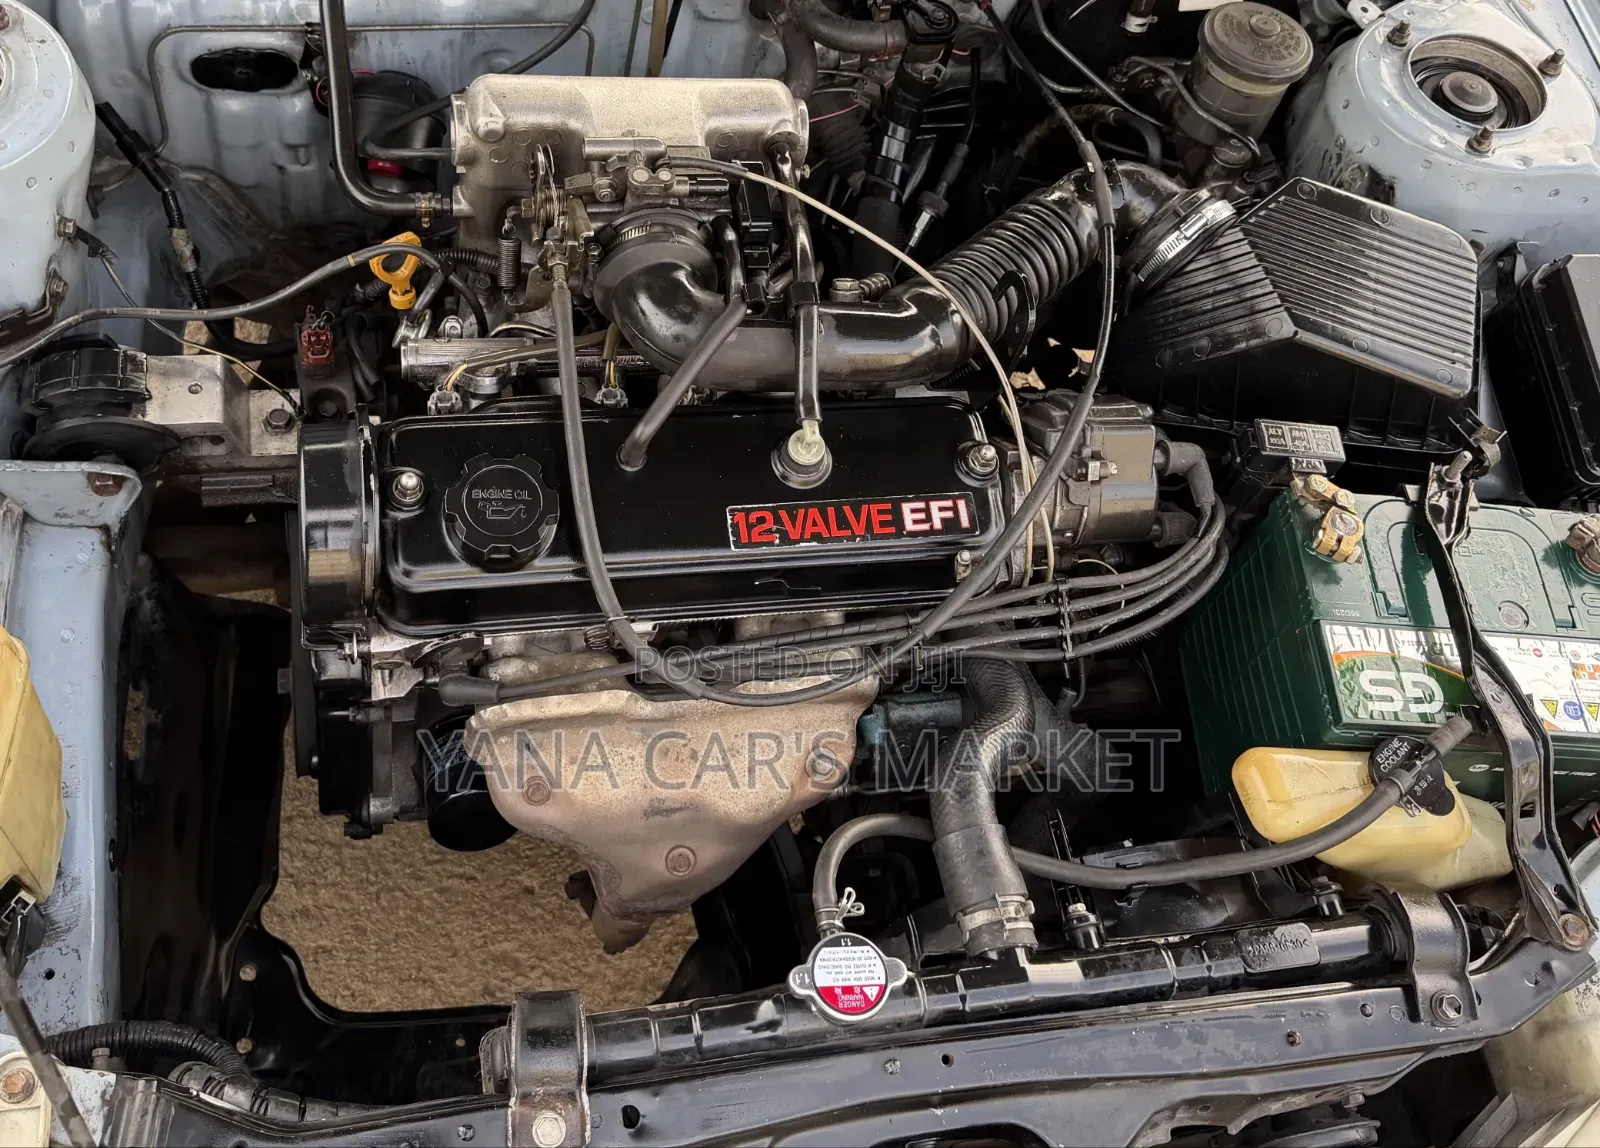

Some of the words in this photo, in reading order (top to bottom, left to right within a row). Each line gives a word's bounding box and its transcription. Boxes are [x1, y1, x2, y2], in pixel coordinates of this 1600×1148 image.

[471, 488, 513, 499] ENGINE
[514, 489, 533, 500] OIL
[778, 503, 895, 540] VALVE
[901, 498, 971, 532] EFI
[1359, 669, 1444, 713] GS
[1376, 737, 1402, 763] ENGINE
[1380, 741, 1411, 772] COOLANT
[795, 972, 810, 985] 1.1
[838, 993, 865, 1001] WARNING
[838, 1000, 866, 1008] DANGER
